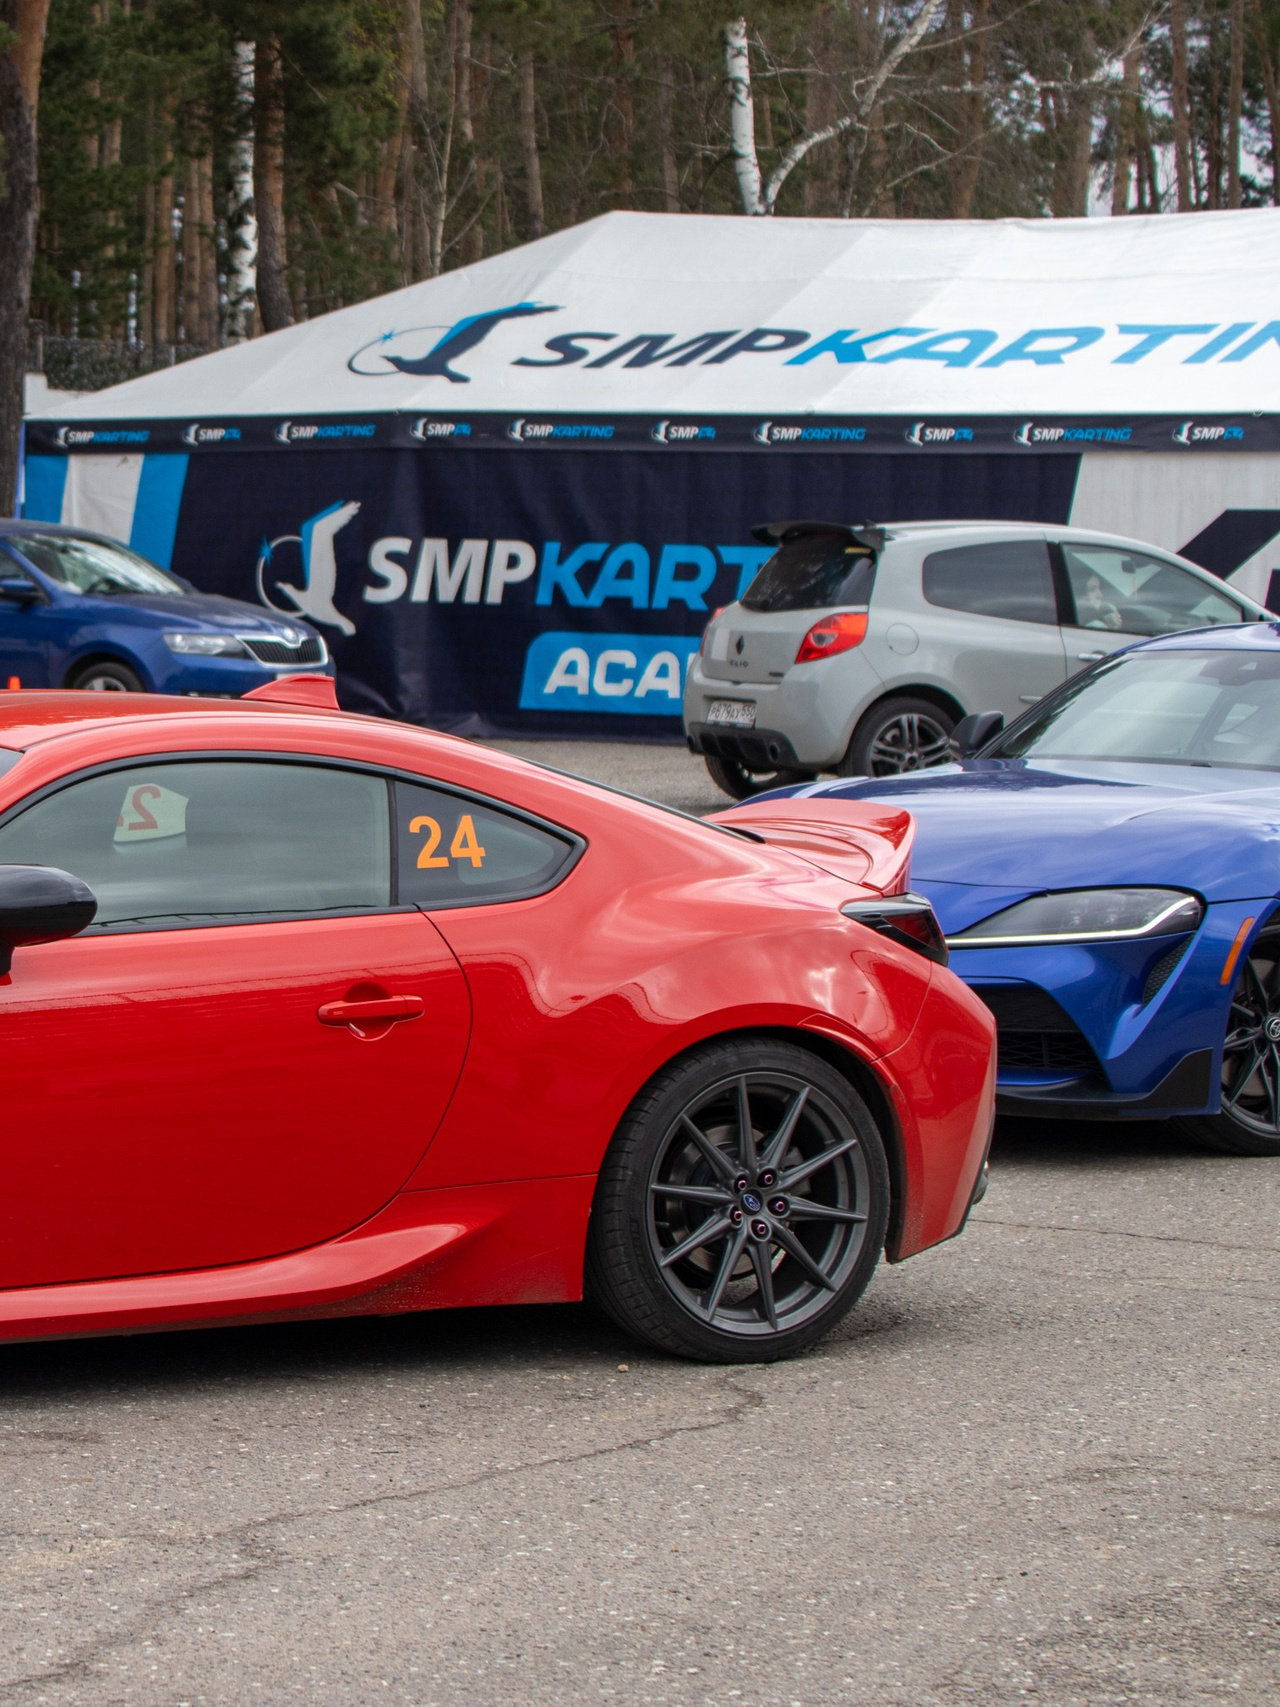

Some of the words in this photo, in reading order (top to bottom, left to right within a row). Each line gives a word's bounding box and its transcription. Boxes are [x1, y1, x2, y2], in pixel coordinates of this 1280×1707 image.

[69, 430, 150, 444] SMPKARTING
[291, 424, 375, 438] SMPKARTING
[525, 425, 614, 438] SMPKARTING
[772, 427, 866, 441] SMPKARTING
[1033, 427, 1132, 441] SMPKARTING
[729, 660, 749, 668] CLIO
[543, 647, 696, 699] ACA
[409, 814, 486, 869] 24
